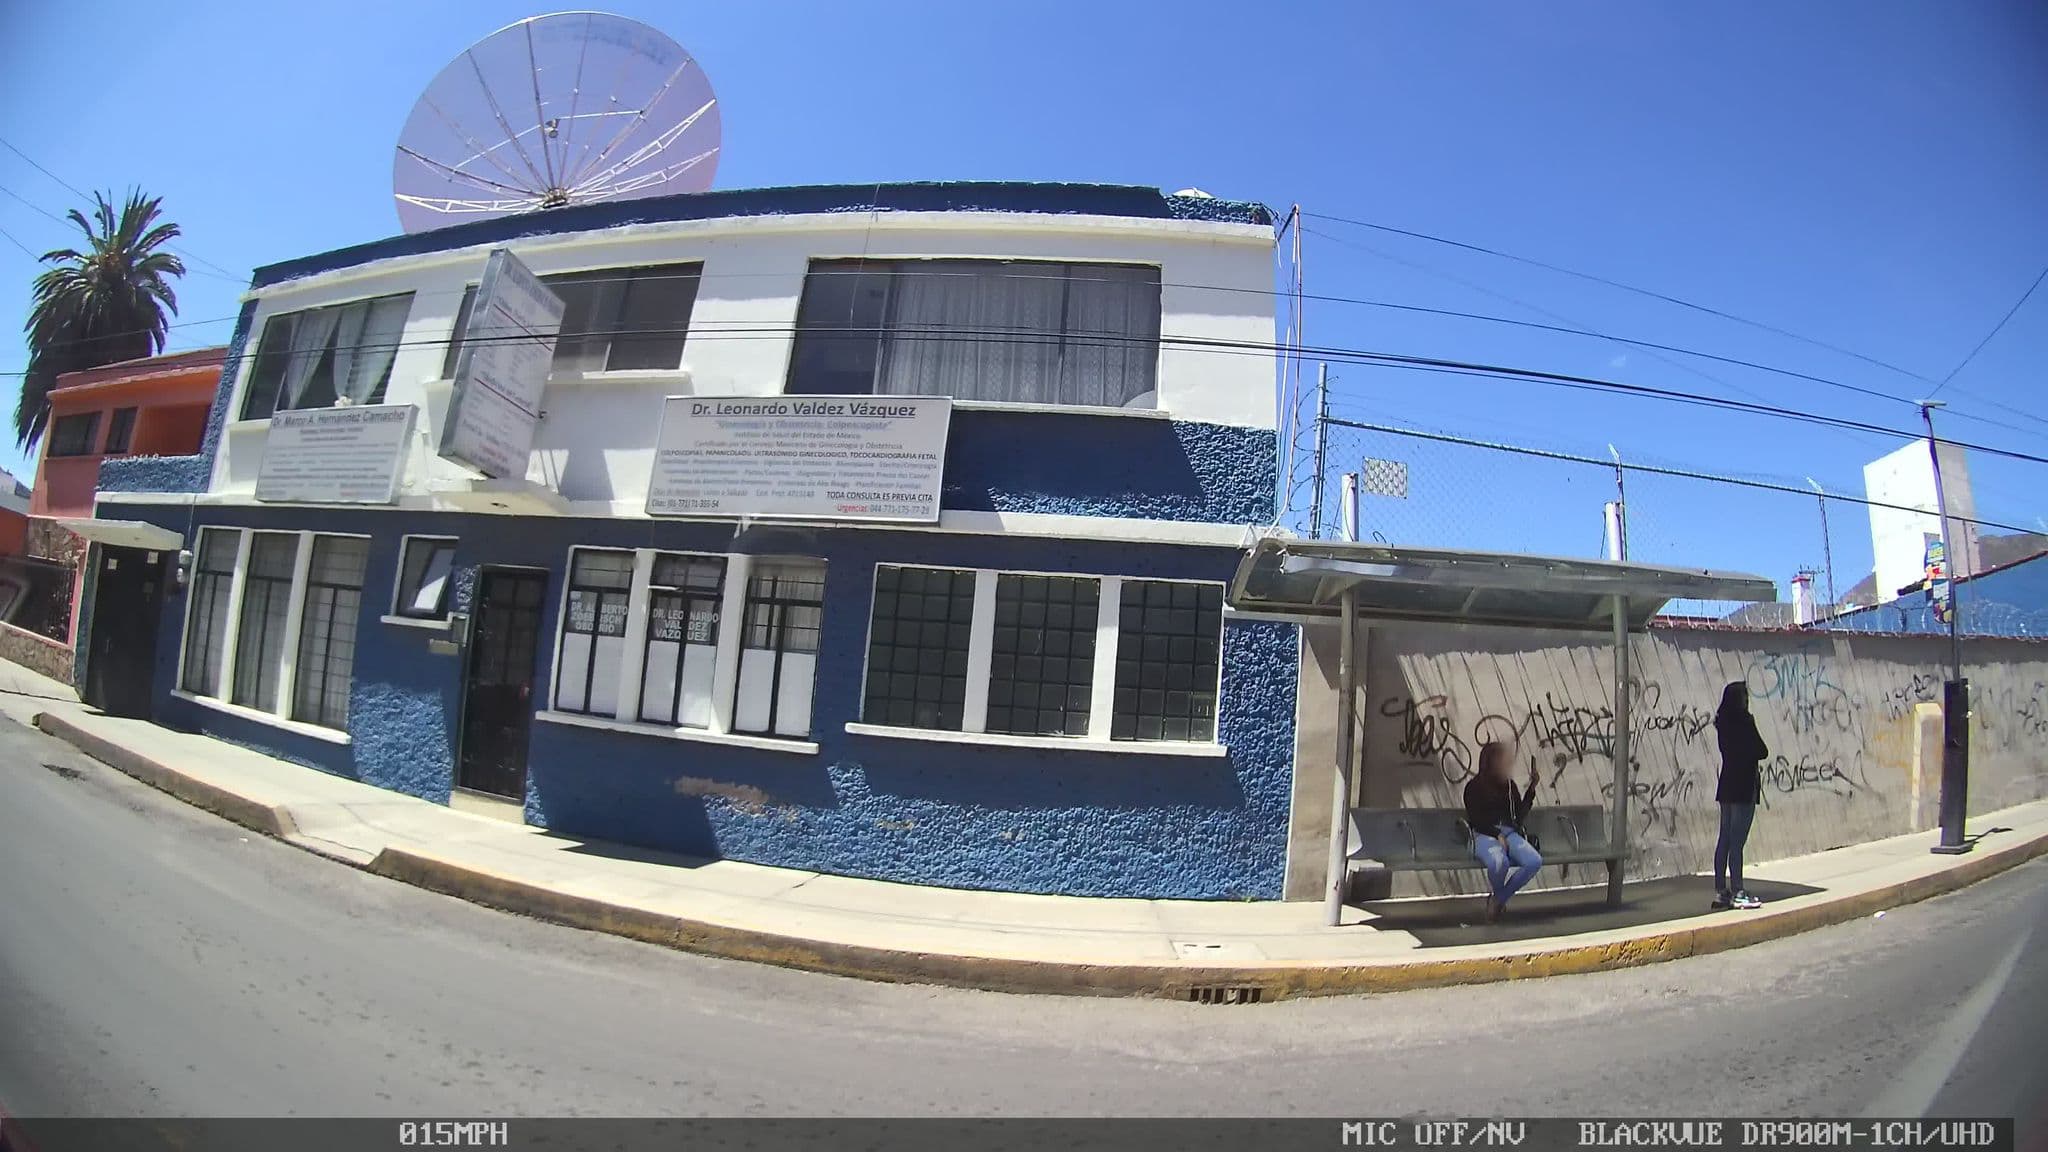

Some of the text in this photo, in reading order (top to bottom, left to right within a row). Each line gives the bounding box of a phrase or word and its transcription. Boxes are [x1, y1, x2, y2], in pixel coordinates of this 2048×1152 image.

[691, 401, 916, 418] Dr. Leonardo Valdez Vázquez
[827, 491, 933, 502] TODA CONSULTA ES PREVIA CITA
[653, 608, 666, 618] DR.
